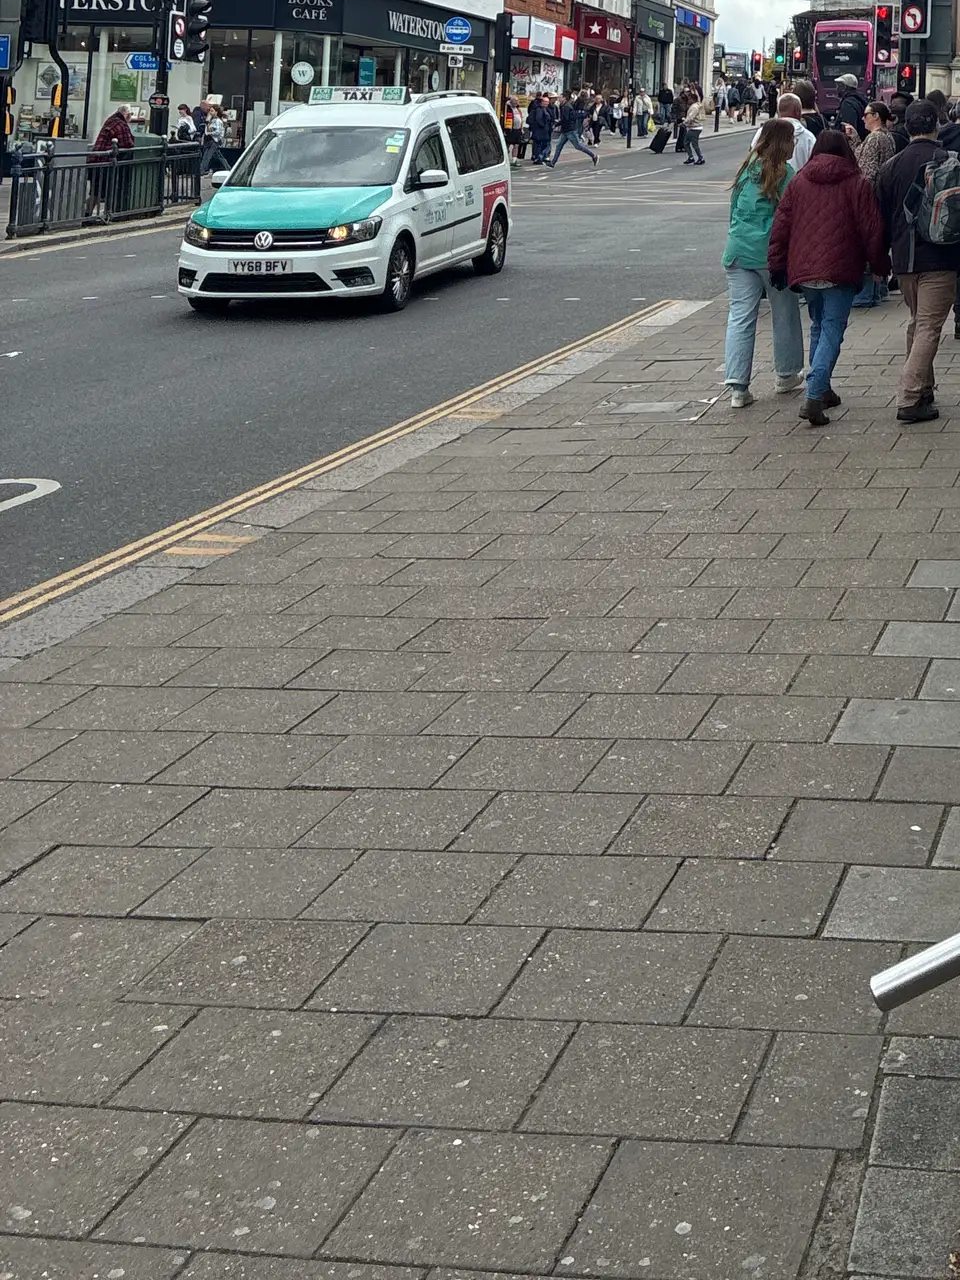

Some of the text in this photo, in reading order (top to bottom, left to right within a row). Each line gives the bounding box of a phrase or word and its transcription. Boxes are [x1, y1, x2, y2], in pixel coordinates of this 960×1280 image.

[292, 7, 327, 21] CAFÉ
[139, 61, 156, 69] Space
[343, 92, 373, 101] TAXI
[233, 260, 287, 272] YY68 BFV
